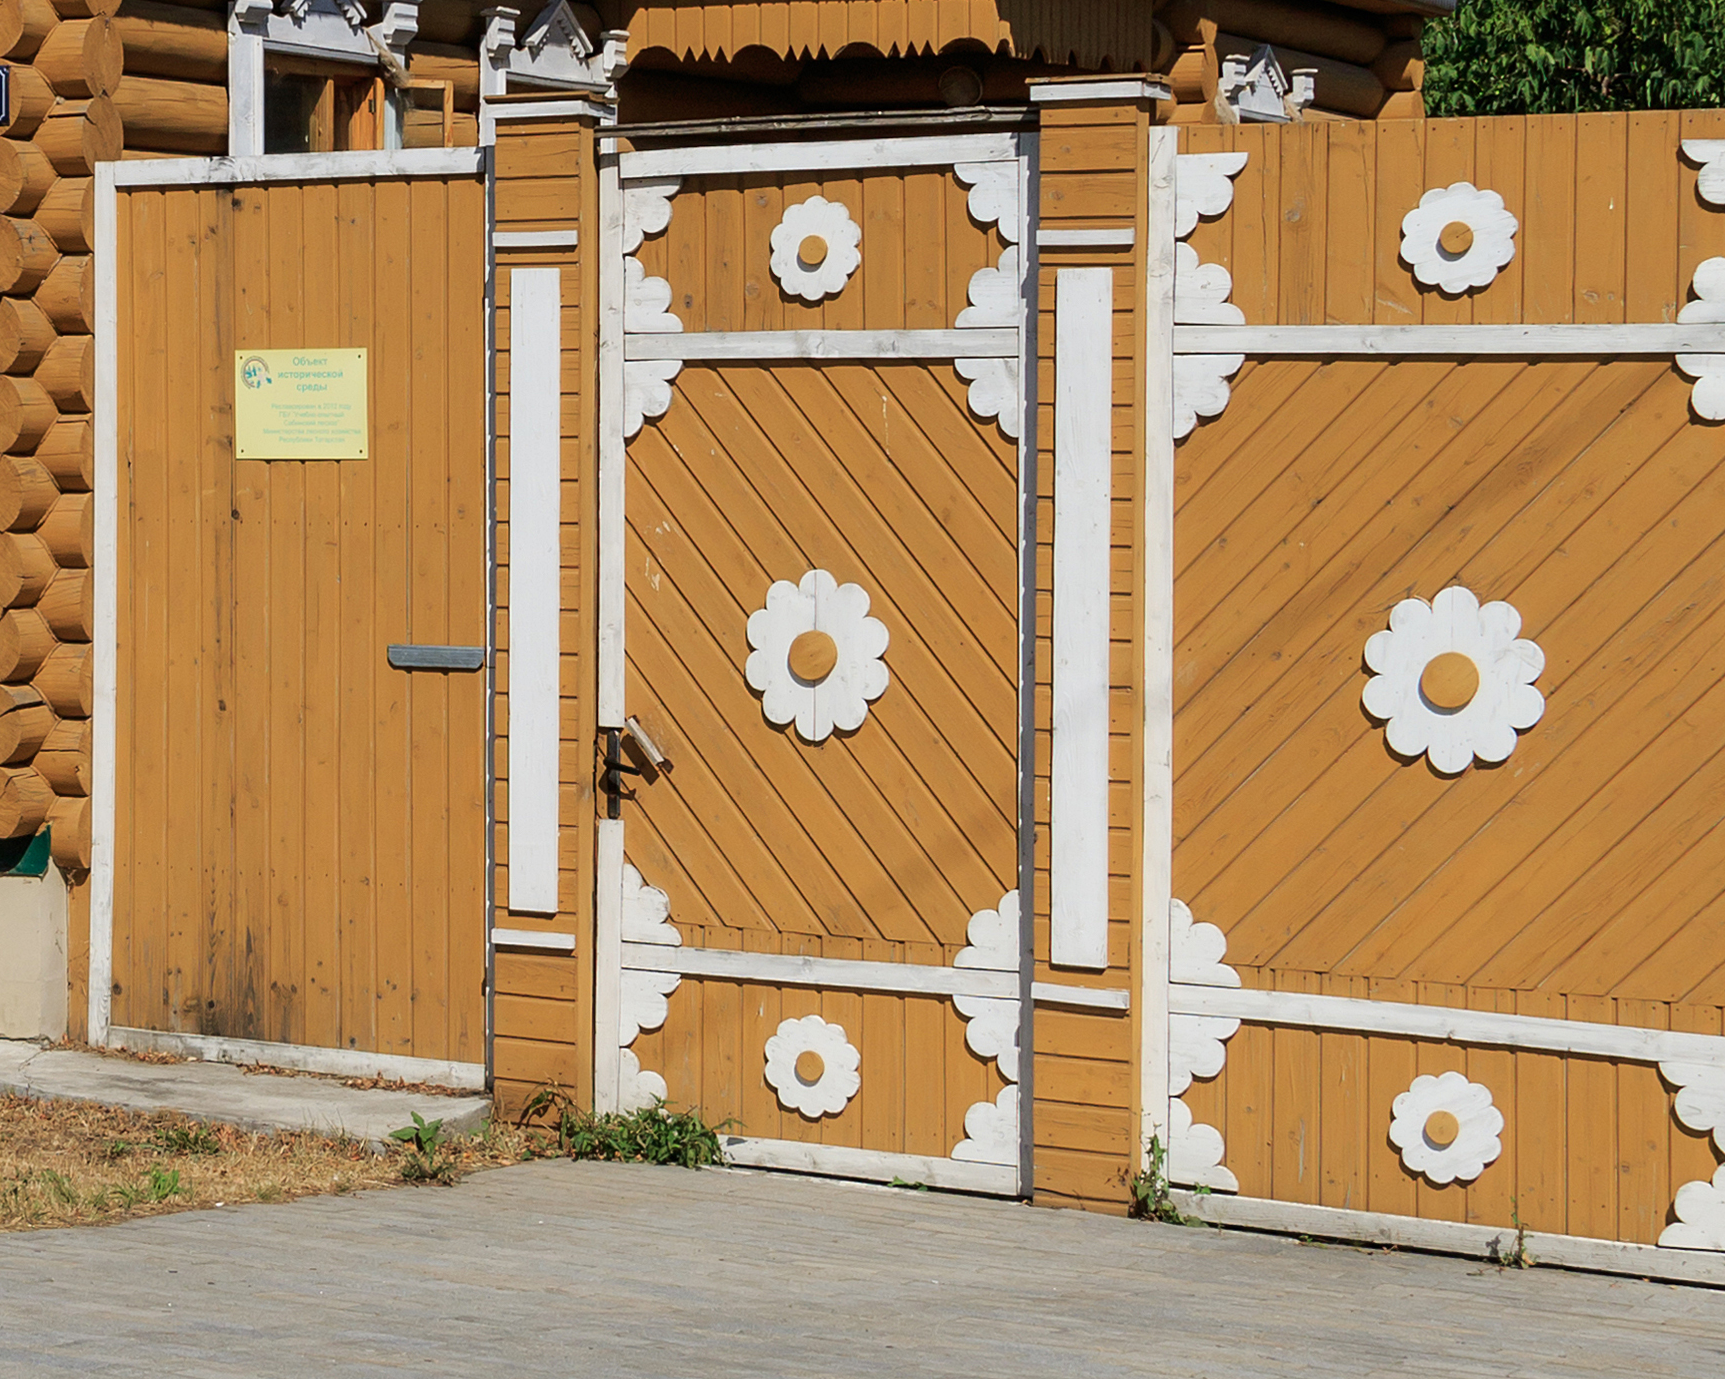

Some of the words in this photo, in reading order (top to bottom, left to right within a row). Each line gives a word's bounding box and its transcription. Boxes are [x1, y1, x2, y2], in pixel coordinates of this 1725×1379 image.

[292, 356, 328, 366] Объект
[278, 369, 343, 380] исторической
[296, 383, 327, 393] среды
